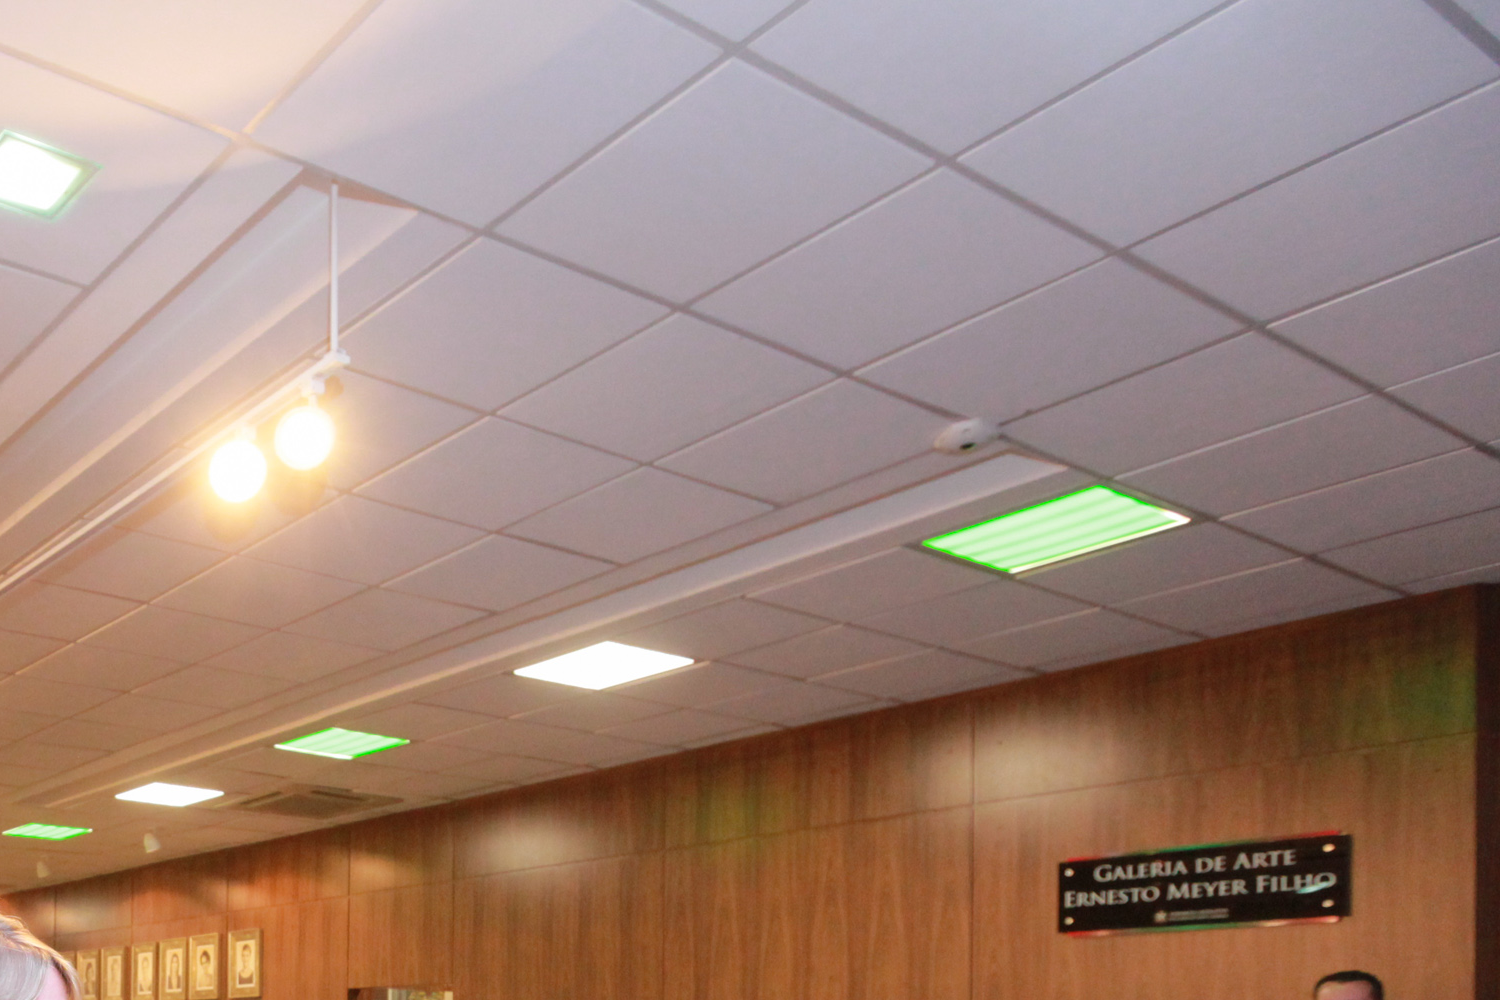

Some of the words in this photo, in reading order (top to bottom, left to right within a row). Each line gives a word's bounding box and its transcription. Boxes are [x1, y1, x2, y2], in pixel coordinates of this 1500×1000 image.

[1093, 860, 1189, 883] GALERIA
[1194, 855, 1227, 874] DE
[1232, 849, 1297, 871] ARTE
[1064, 886, 1160, 909] ERNESTO
[1166, 879, 1249, 901] MEYER
[1256, 872, 1337, 893] FILHO
